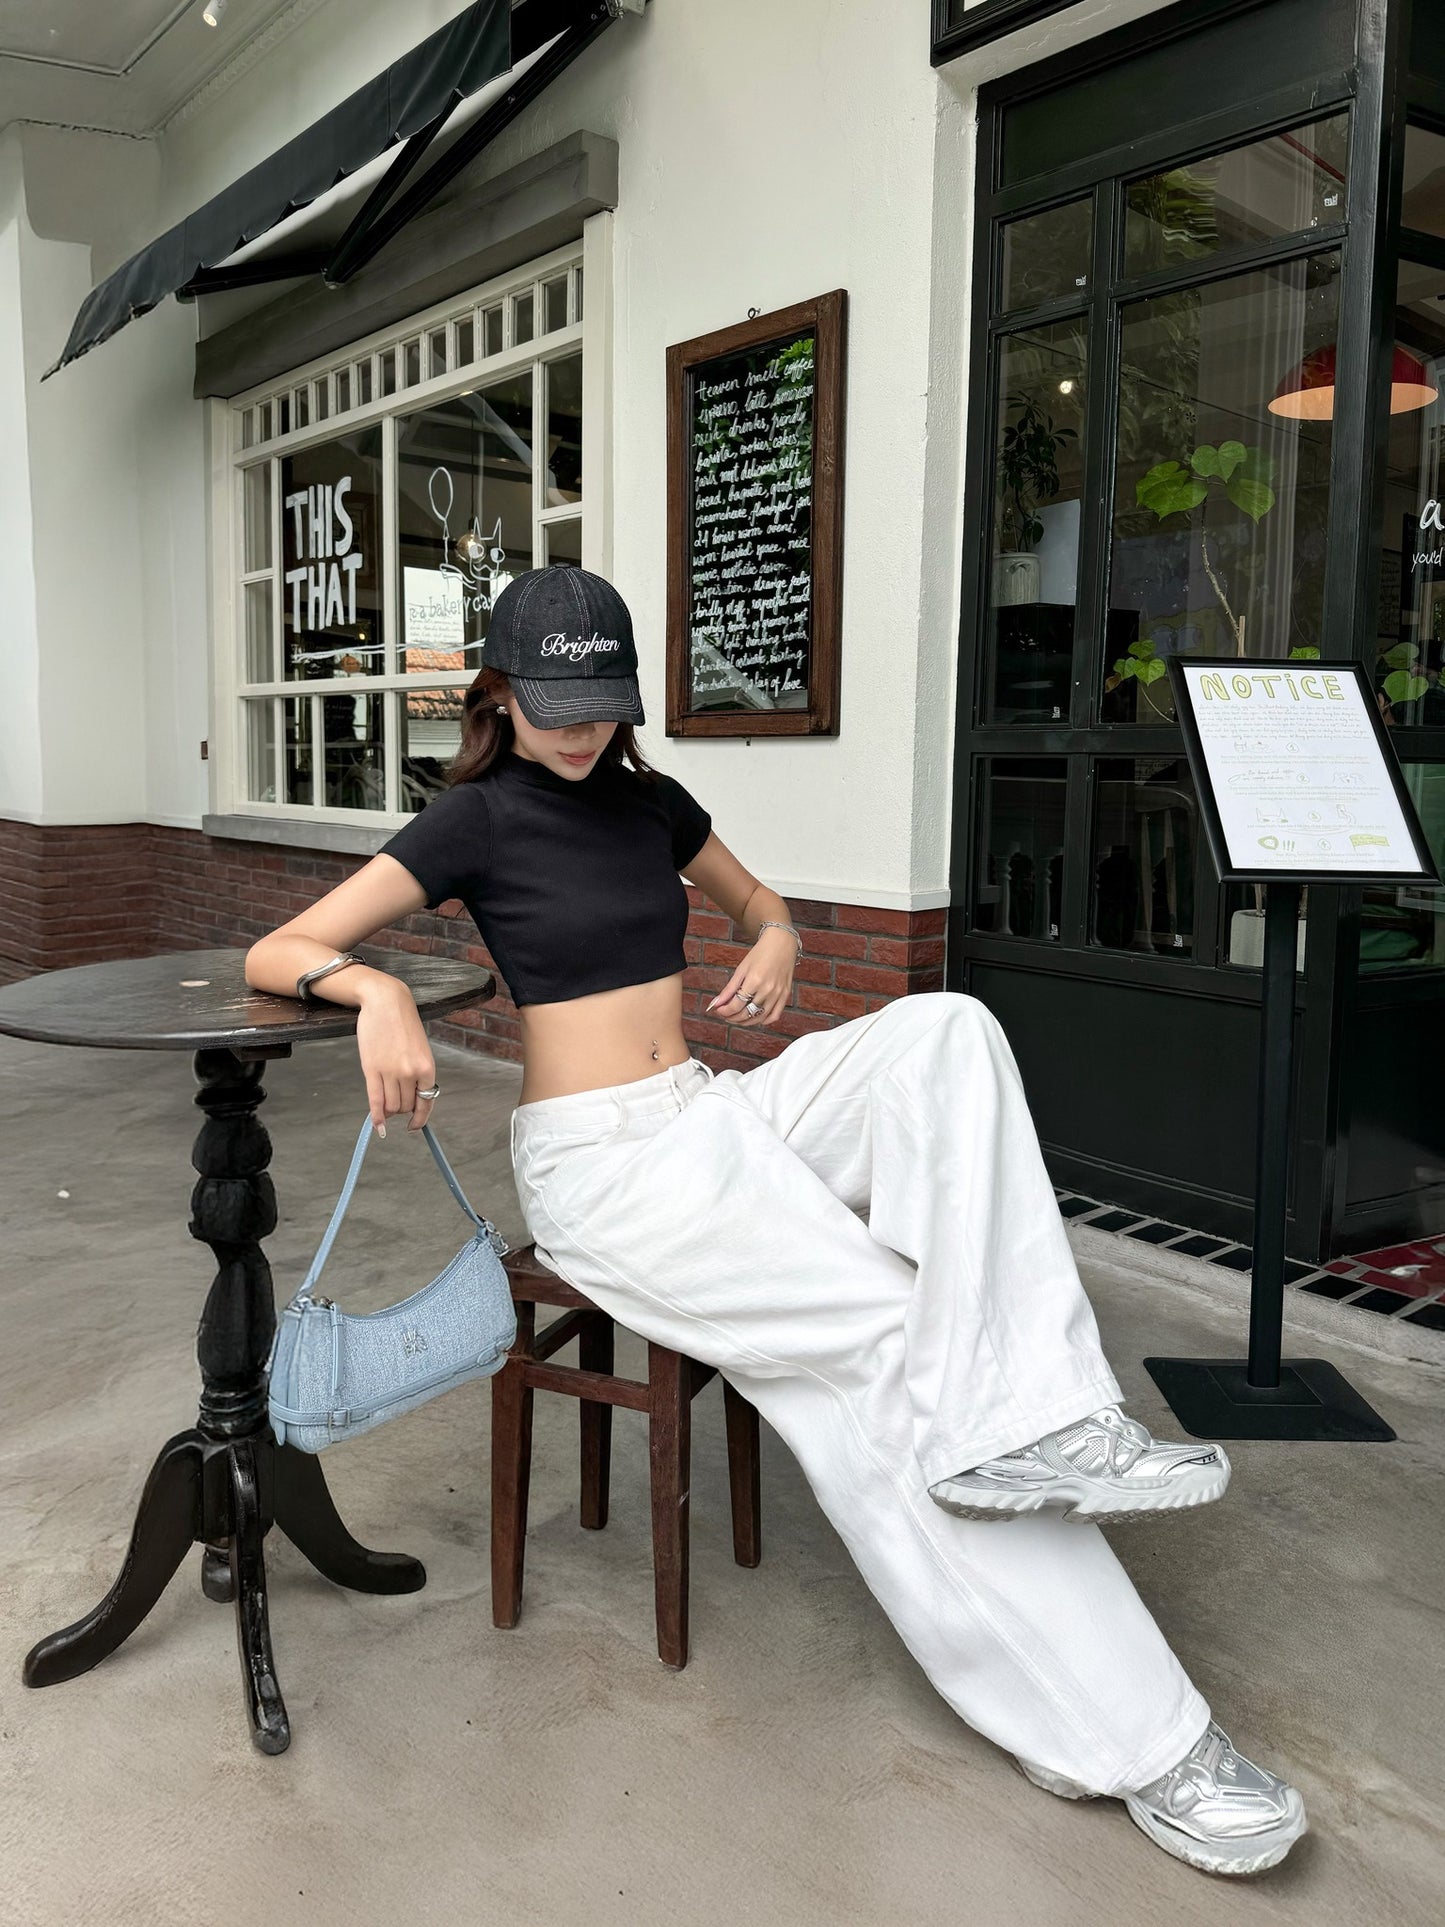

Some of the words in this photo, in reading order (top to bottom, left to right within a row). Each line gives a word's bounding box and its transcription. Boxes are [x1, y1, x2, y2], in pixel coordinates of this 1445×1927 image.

[695, 379, 740, 402] Heaven
[744, 359, 780, 387] smell
[783, 357, 814, 382] coffee
[286, 476, 353, 560] THIS
[788, 537, 811, 550] nice
[286, 552, 363, 634] THAT
[429, 594, 471, 623] bakery
[541, 632, 620, 662] Brighten
